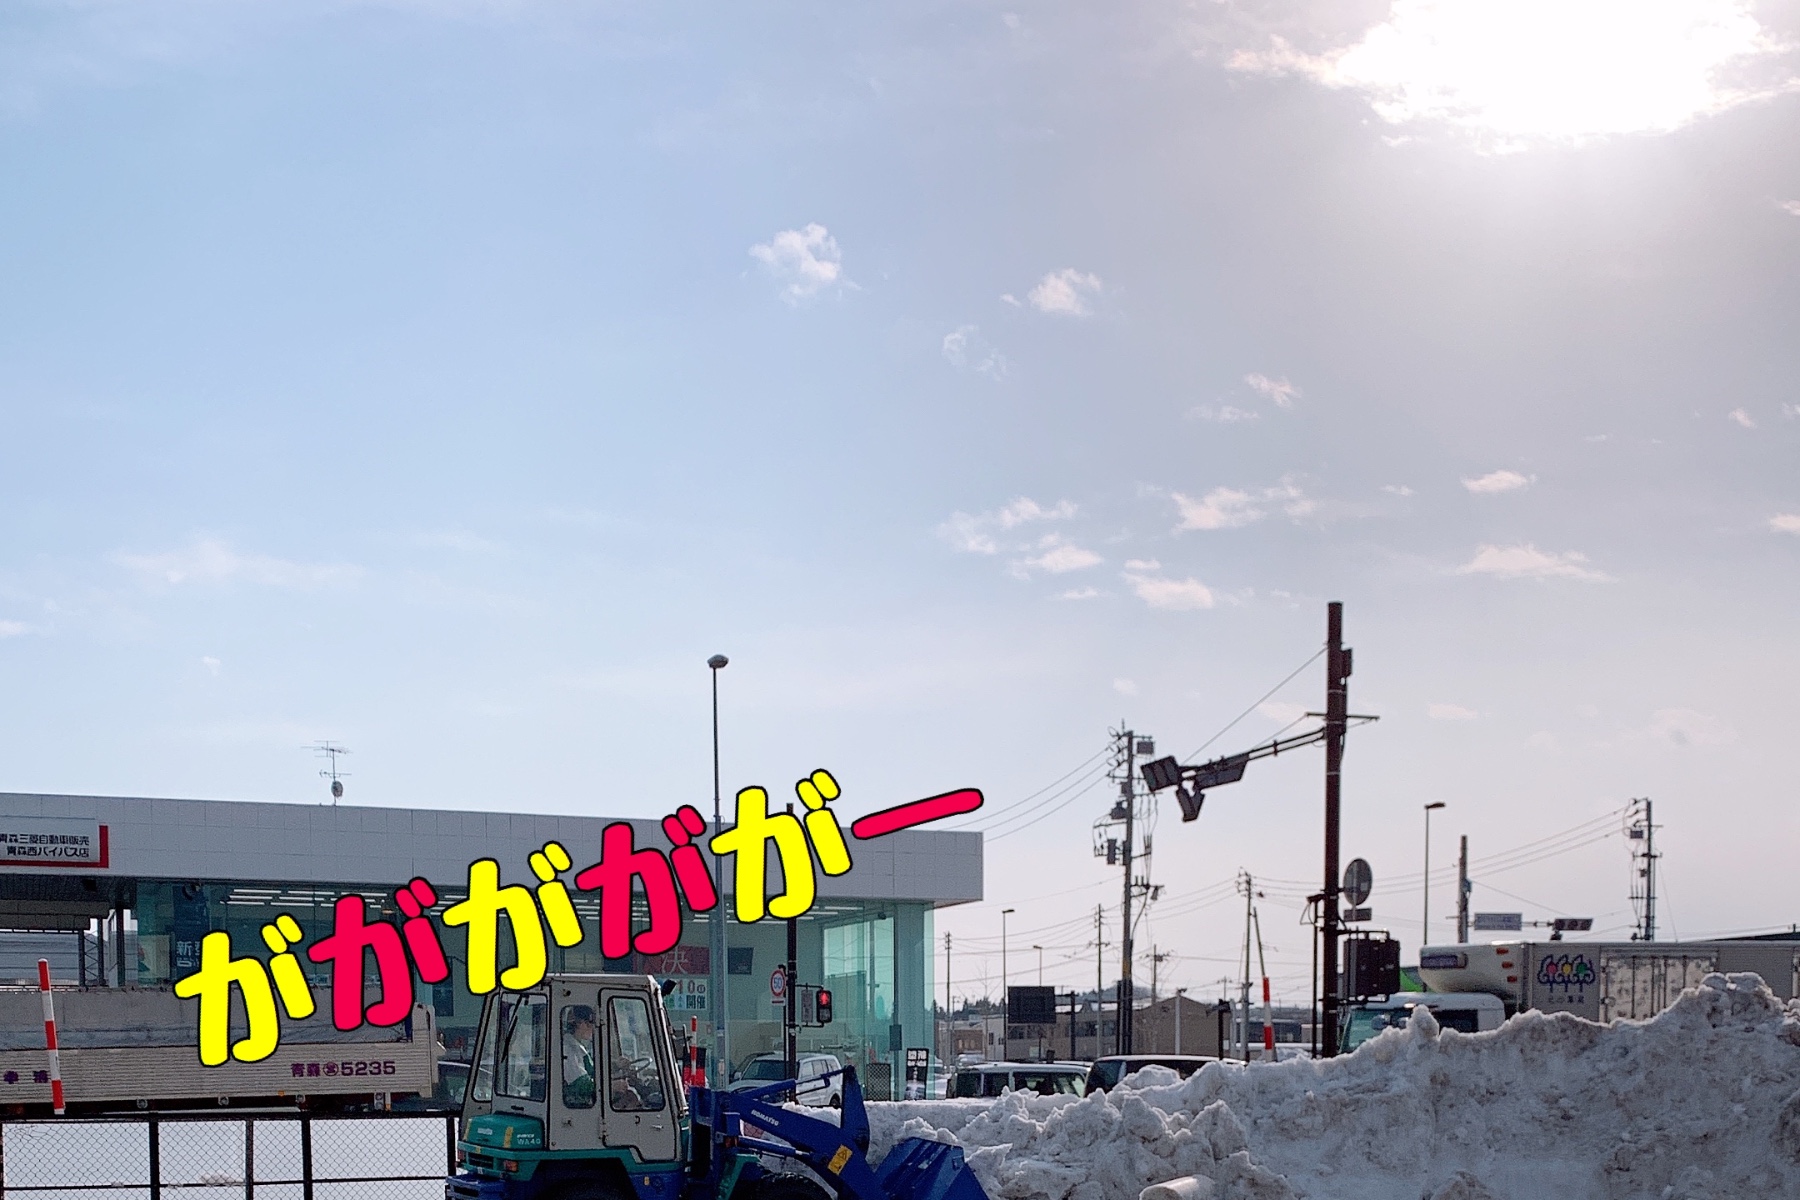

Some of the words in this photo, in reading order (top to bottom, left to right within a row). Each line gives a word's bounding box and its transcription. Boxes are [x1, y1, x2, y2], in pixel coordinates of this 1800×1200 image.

[7, 845, 90, 858] 青森西バイパス店
[773, 976, 784, 990] 50
[750, 1109, 780, 1127] KOMATSU
